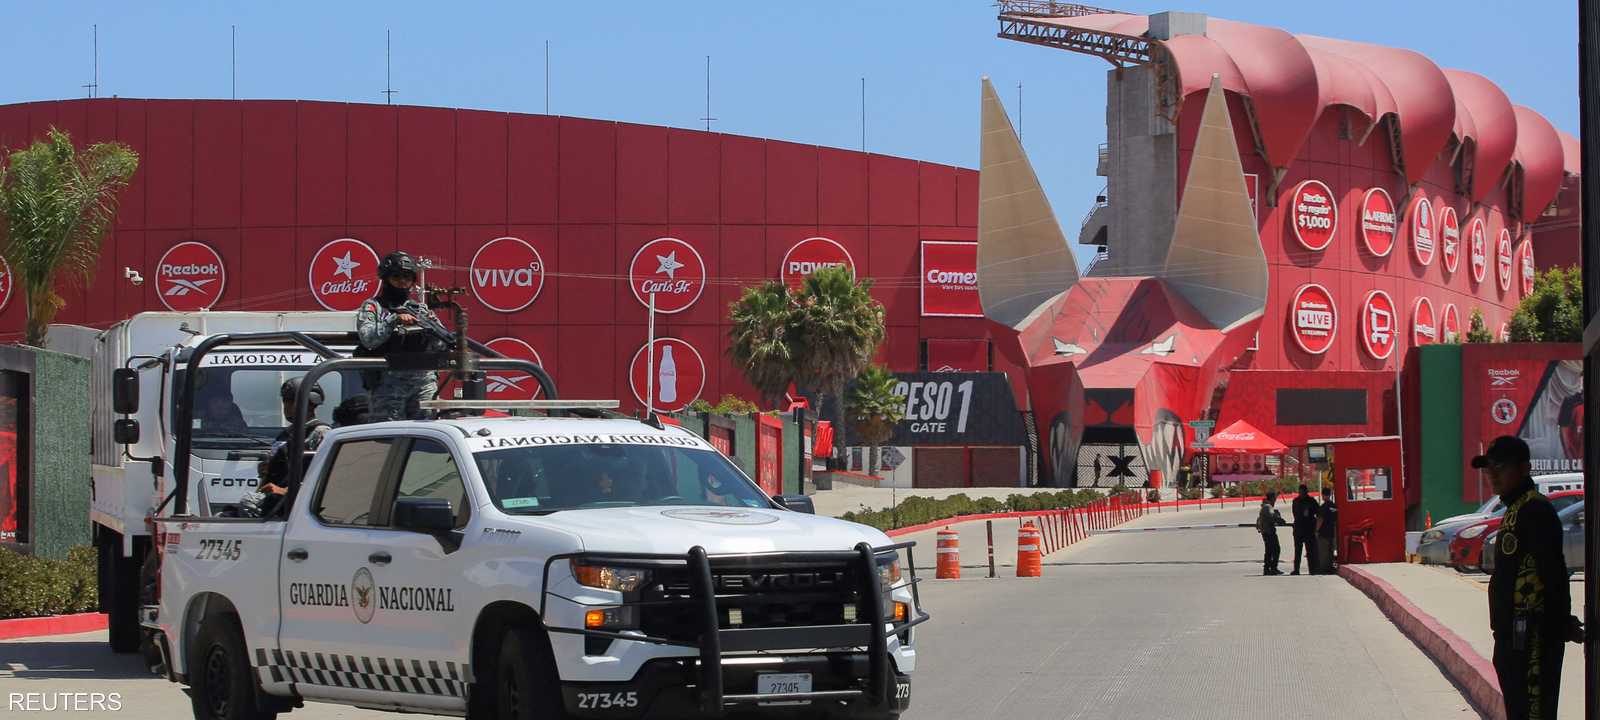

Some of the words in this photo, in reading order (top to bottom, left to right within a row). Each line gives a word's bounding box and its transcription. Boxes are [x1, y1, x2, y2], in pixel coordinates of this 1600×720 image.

[1298, 215, 1331, 229] $1,000
[161, 263, 219, 277] Reebok
[789, 261, 848, 275] POWE
[320, 279, 351, 295] Carl's
[351, 280, 368, 294] Jr.
[641, 279, 673, 294] Carl's
[673, 280, 691, 294] Jr.
[1307, 313, 1329, 325] LIVE
[1488, 368, 1520, 376] Reebok
[889, 381, 954, 420] CESO
[957, 379, 974, 433] 1
[910, 422, 947, 433] GATE
[1572, 459, 1583, 470] CA
[211, 478, 259, 487] FOTO
[196, 539, 242, 561] 27345
[290, 582, 349, 607] GUARDIA
[379, 587, 455, 611] NACIONAL
[895, 683, 909, 698] 273
[577, 691, 638, 708] 27345
